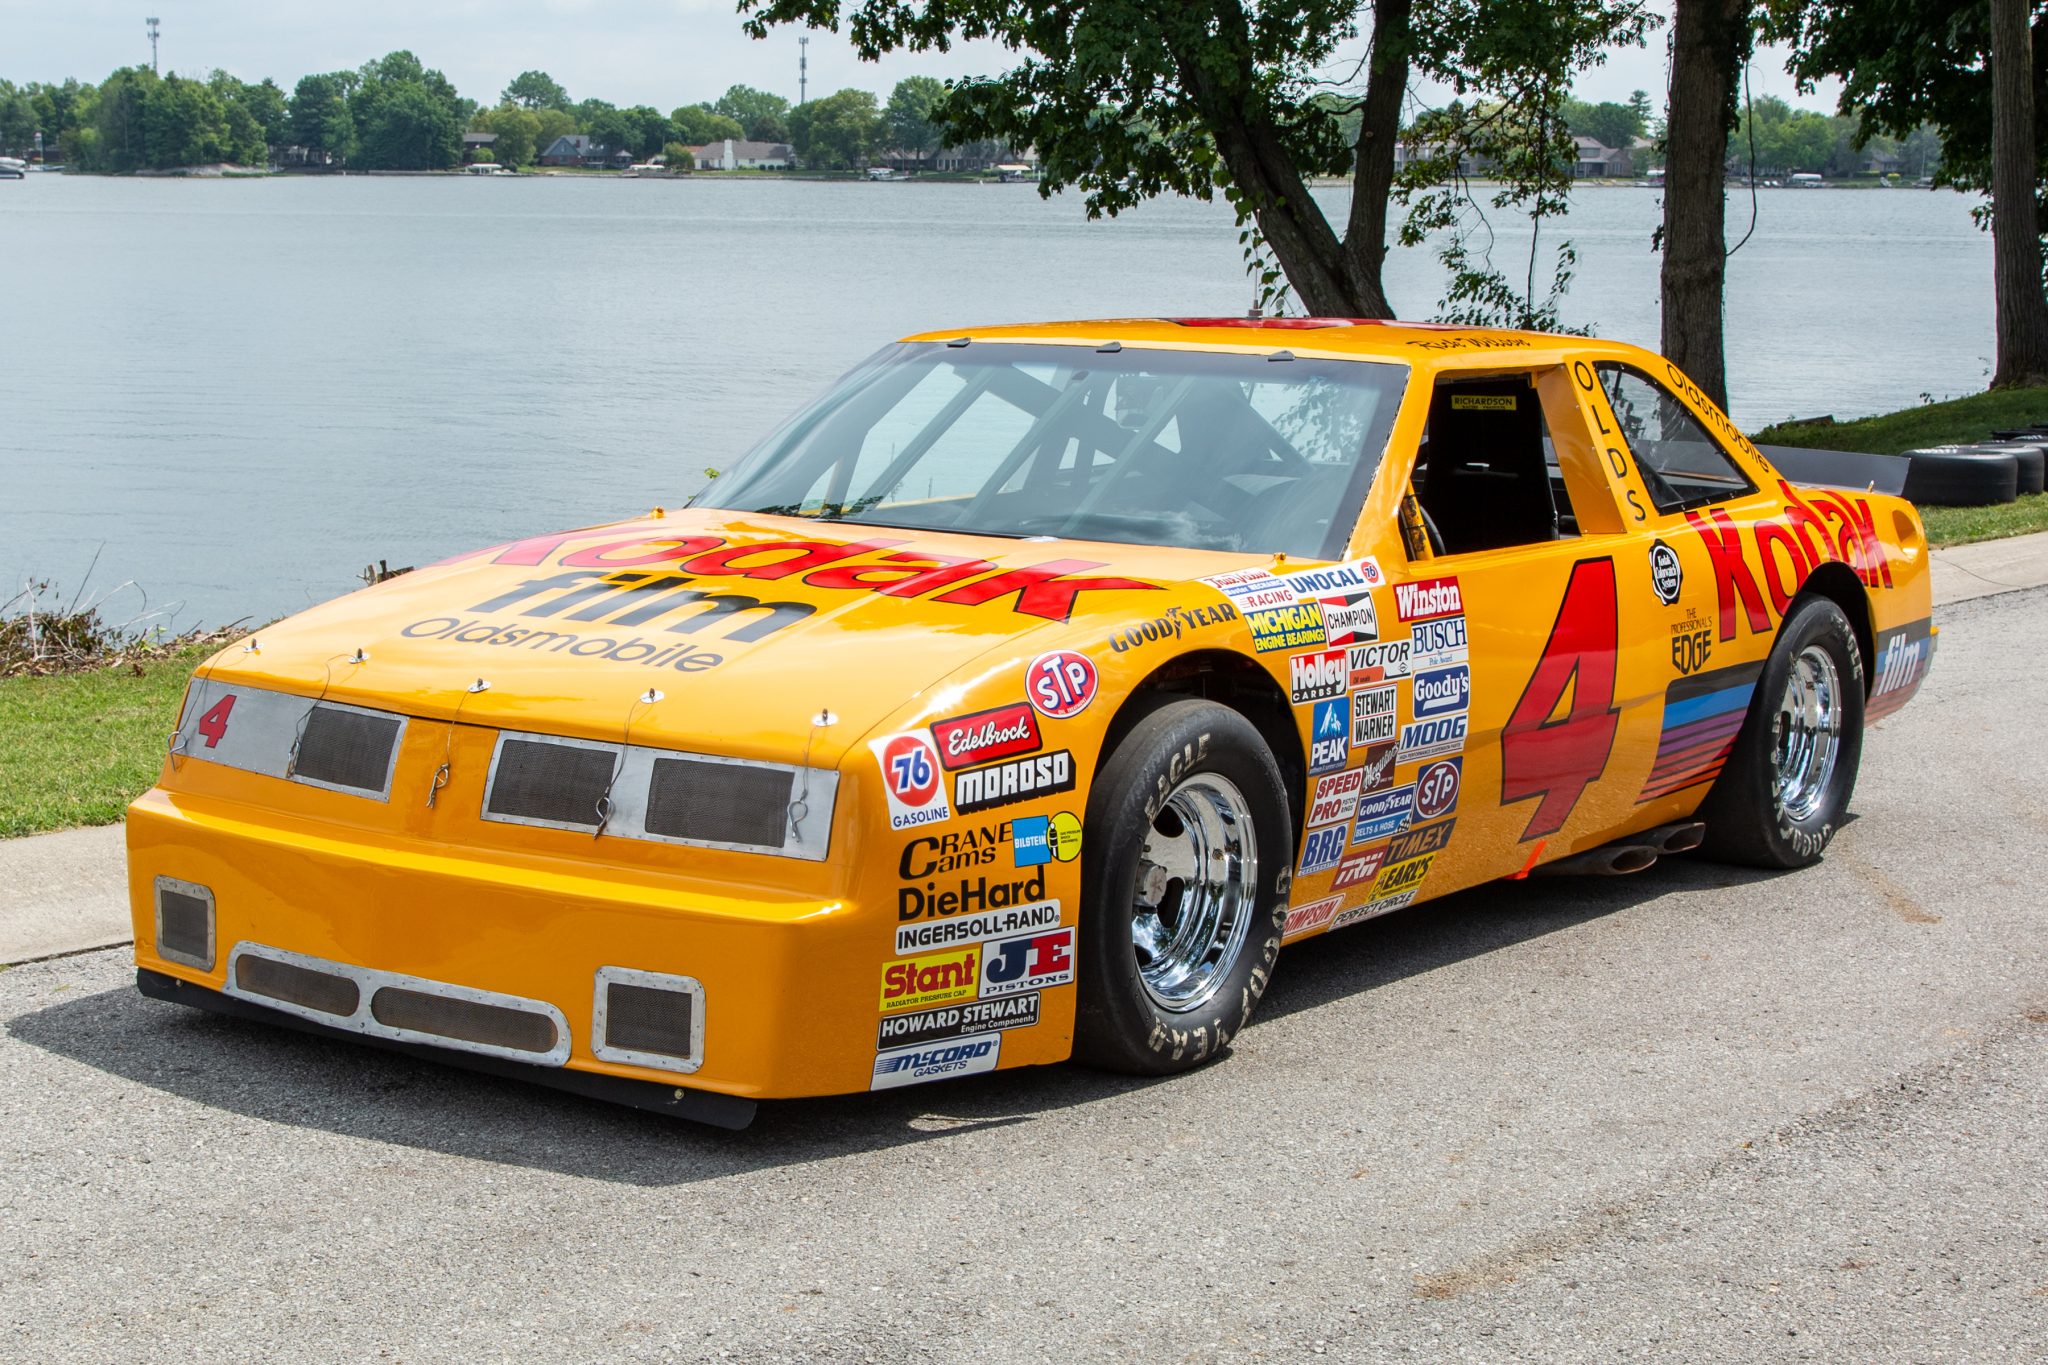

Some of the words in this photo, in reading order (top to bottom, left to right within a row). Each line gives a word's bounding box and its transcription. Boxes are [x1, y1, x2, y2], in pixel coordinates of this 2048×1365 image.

[1454, 397, 1513, 406] RICHARDSON
[1667, 364, 1769, 474] Oldsmobile
[1364, 565, 1376, 578] 76
[1684, 480, 1893, 642] Kodak
[1247, 589, 1293, 608] RACING
[1287, 568, 1364, 594] UNOCAL
[465, 571, 818, 643] film
[1327, 608, 1374, 630] CHAMPION
[1396, 584, 1461, 619] Winston
[1686, 607, 1697, 620] THE
[1246, 604, 1323, 637] MICHIGAN
[1412, 619, 1468, 654] BUSCH
[401, 617, 724, 673] Oldsmobile
[1254, 633, 1286, 652] ENGINE
[1285, 629, 1326, 647] BEARINGS
[1350, 642, 1410, 670] VICTOR
[1672, 629, 1712, 675] EDGE
[1036, 655, 1088, 710] STP
[1291, 653, 1346, 694] Holley
[1876, 633, 1920, 697] film
[1293, 686, 1332, 701] CARBS
[1355, 688, 1395, 717] STEWART
[1414, 673, 1469, 702] Goody's
[1500, 556, 1620, 843] 4
[199, 694, 237, 748] 4
[948, 715, 1030, 756] Edelbrock
[1355, 715, 1394, 743] WARNER
[1401, 714, 1467, 750] MOOG
[1311, 736, 1348, 767] PEAK
[891, 745, 931, 795] 76
[956, 751, 1070, 807] MOROSO
[1144, 733, 1212, 827] EAGLE
[1316, 771, 1361, 800] SPEED
[1422, 767, 1454, 806] STP
[893, 806, 949, 828] GASOLINE
[1311, 798, 1342, 824] PRO
[1356, 823, 1375, 838] BELTS
[1374, 823, 1379, 833] &
[1379, 819, 1396, 831] HOSE
[1014, 834, 1047, 849] BILSTEIN
[1300, 825, 1347, 869] BRC
[1387, 823, 1450, 862] TIMEX
[1335, 852, 1383, 886] TRW
[1383, 855, 1434, 891] EARL'S
[898, 864, 1046, 922] DieHard
[1334, 902, 1381, 926] PERFECT
[1379, 890, 1416, 911] CIRCLE
[898, 905, 1056, 950] INGERSOLL-RAND
[1283, 899, 1338, 934] SIMPSON
[985, 930, 1072, 984] JE
[884, 953, 975, 999] Stant
[985, 973, 1070, 995] PISTONS
[881, 1009, 960, 1038] HOWARD
[962, 995, 1038, 1024] STEWART
[886, 997, 919, 1009] RADIATOR
[920, 992, 952, 1003] PRESSURE
[953, 989, 967, 998] CAP
[961, 1022, 987, 1034] Engine
[987, 1014, 1035, 1028] Components
[913, 1060, 968, 1078] GASKETS
